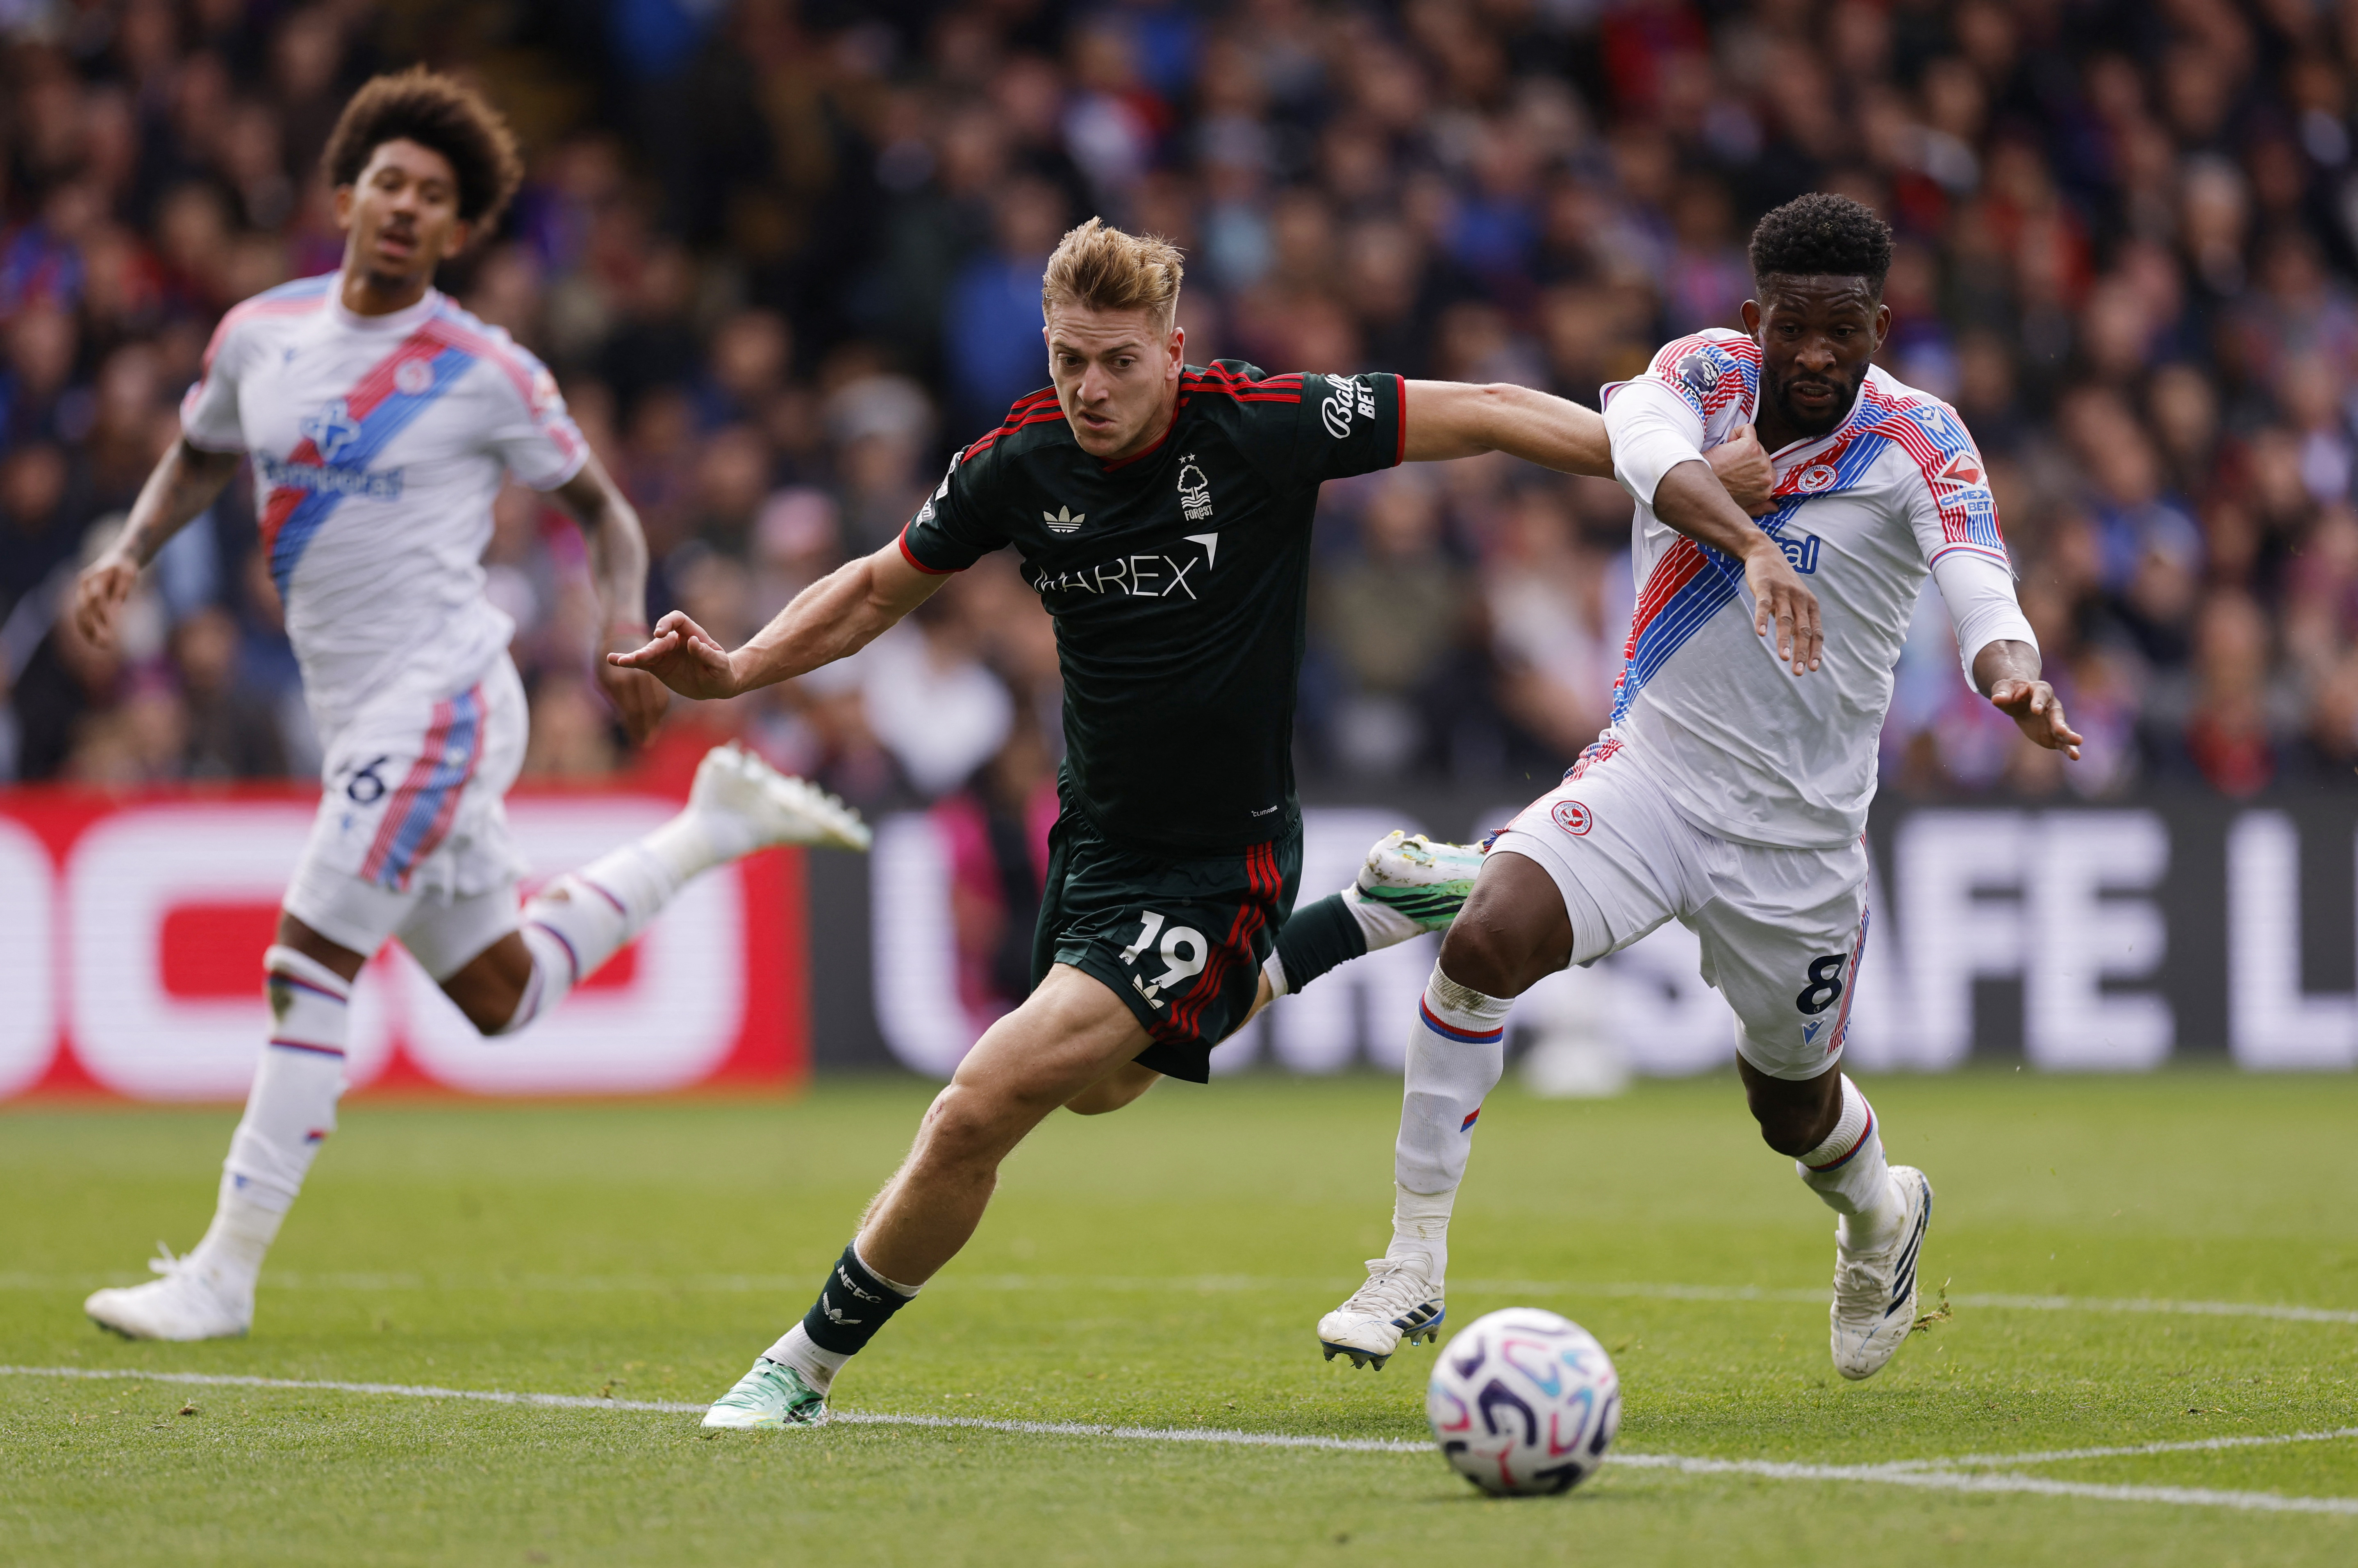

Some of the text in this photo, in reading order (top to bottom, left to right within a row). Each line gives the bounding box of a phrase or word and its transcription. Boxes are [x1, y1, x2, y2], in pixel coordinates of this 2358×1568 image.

[1355, 381, 1375, 420] BET
[1801, 466, 1835, 479] CRYSTAL PALACE
[1940, 490, 1991, 506] CHEX
[1967, 501, 1990, 512] BET
[1560, 803, 1583, 811] CRYSTAL
[1119, 910, 1208, 989] 19
[1796, 953, 1847, 1015] 8
[837, 1264, 882, 1303] NFFC
